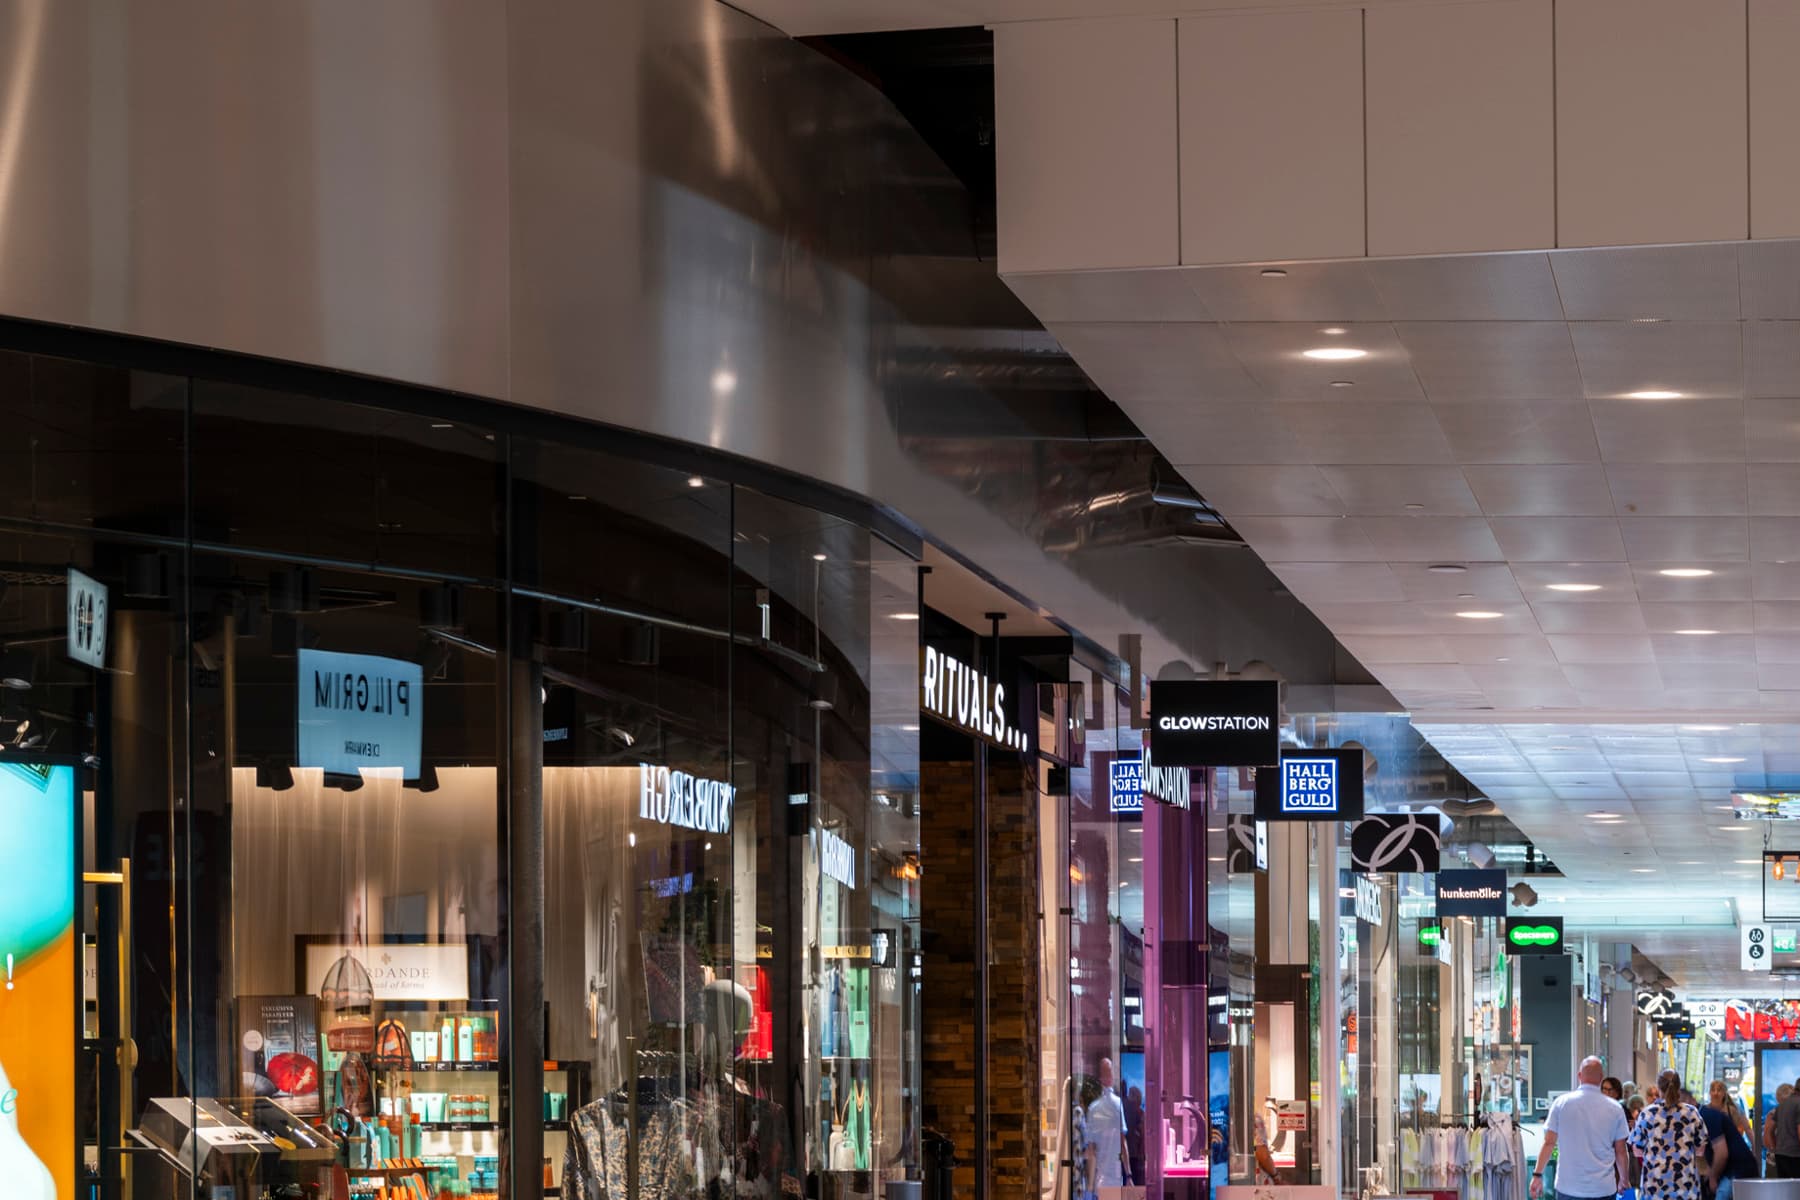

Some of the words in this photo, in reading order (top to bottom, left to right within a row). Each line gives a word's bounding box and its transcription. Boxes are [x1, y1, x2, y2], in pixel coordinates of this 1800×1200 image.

[1159, 716, 1270, 730] GLOWSTATION
[1289, 765, 1329, 778] HALL
[1141, 745, 1191, 812] LOWSTATION
[1289, 794, 1331, 807] GULD
[1439, 887, 1503, 899] hunkemöller
[367, 967, 430, 979] RDANDE
